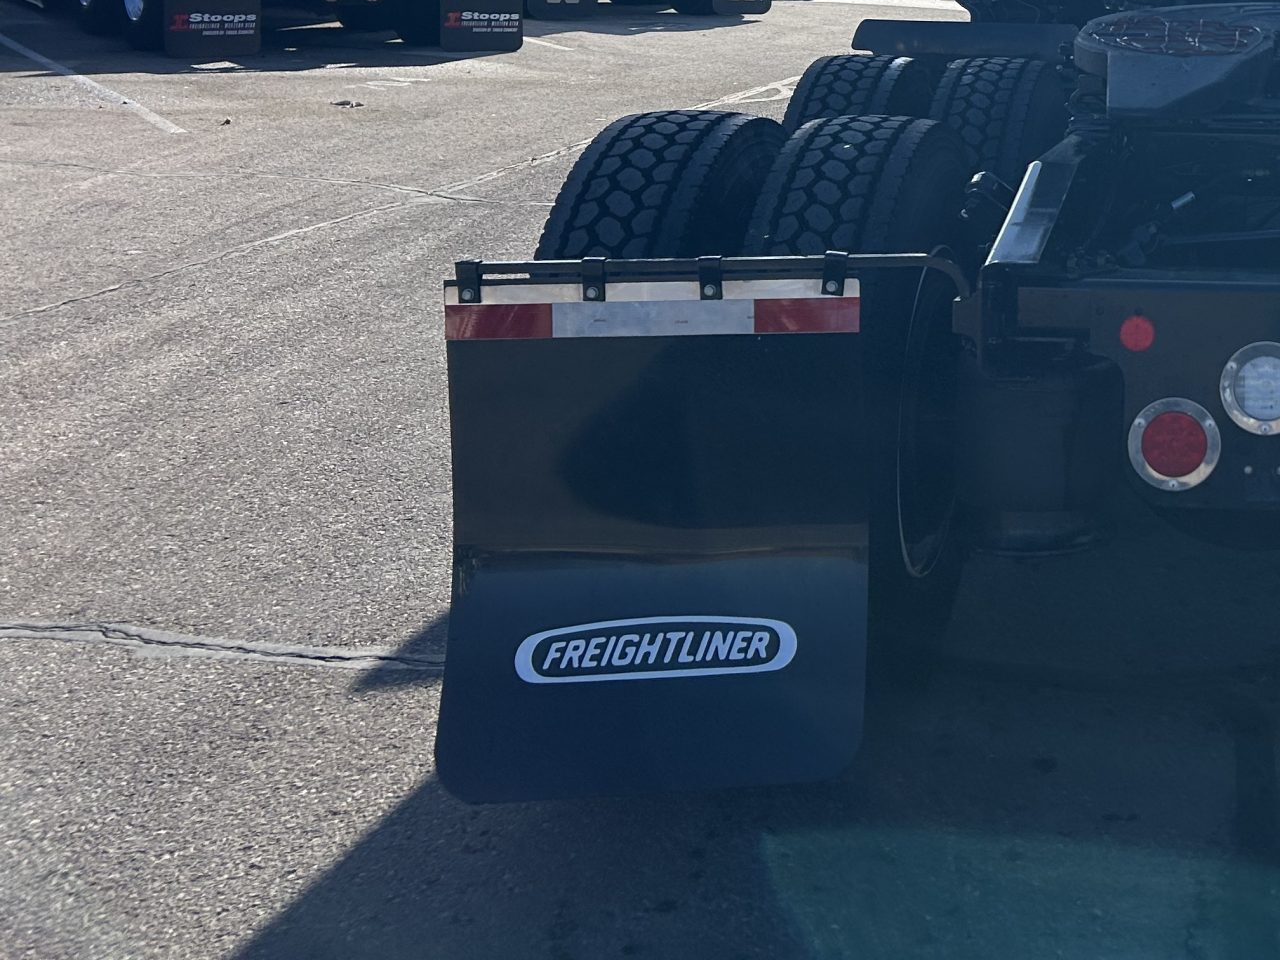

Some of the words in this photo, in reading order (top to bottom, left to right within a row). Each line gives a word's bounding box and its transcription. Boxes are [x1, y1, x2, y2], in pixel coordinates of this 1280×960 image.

[188, 13, 257, 22] Stoops
[461, 11, 520, 21] Stoops
[543, 631, 770, 670] FREIGHTLINER
